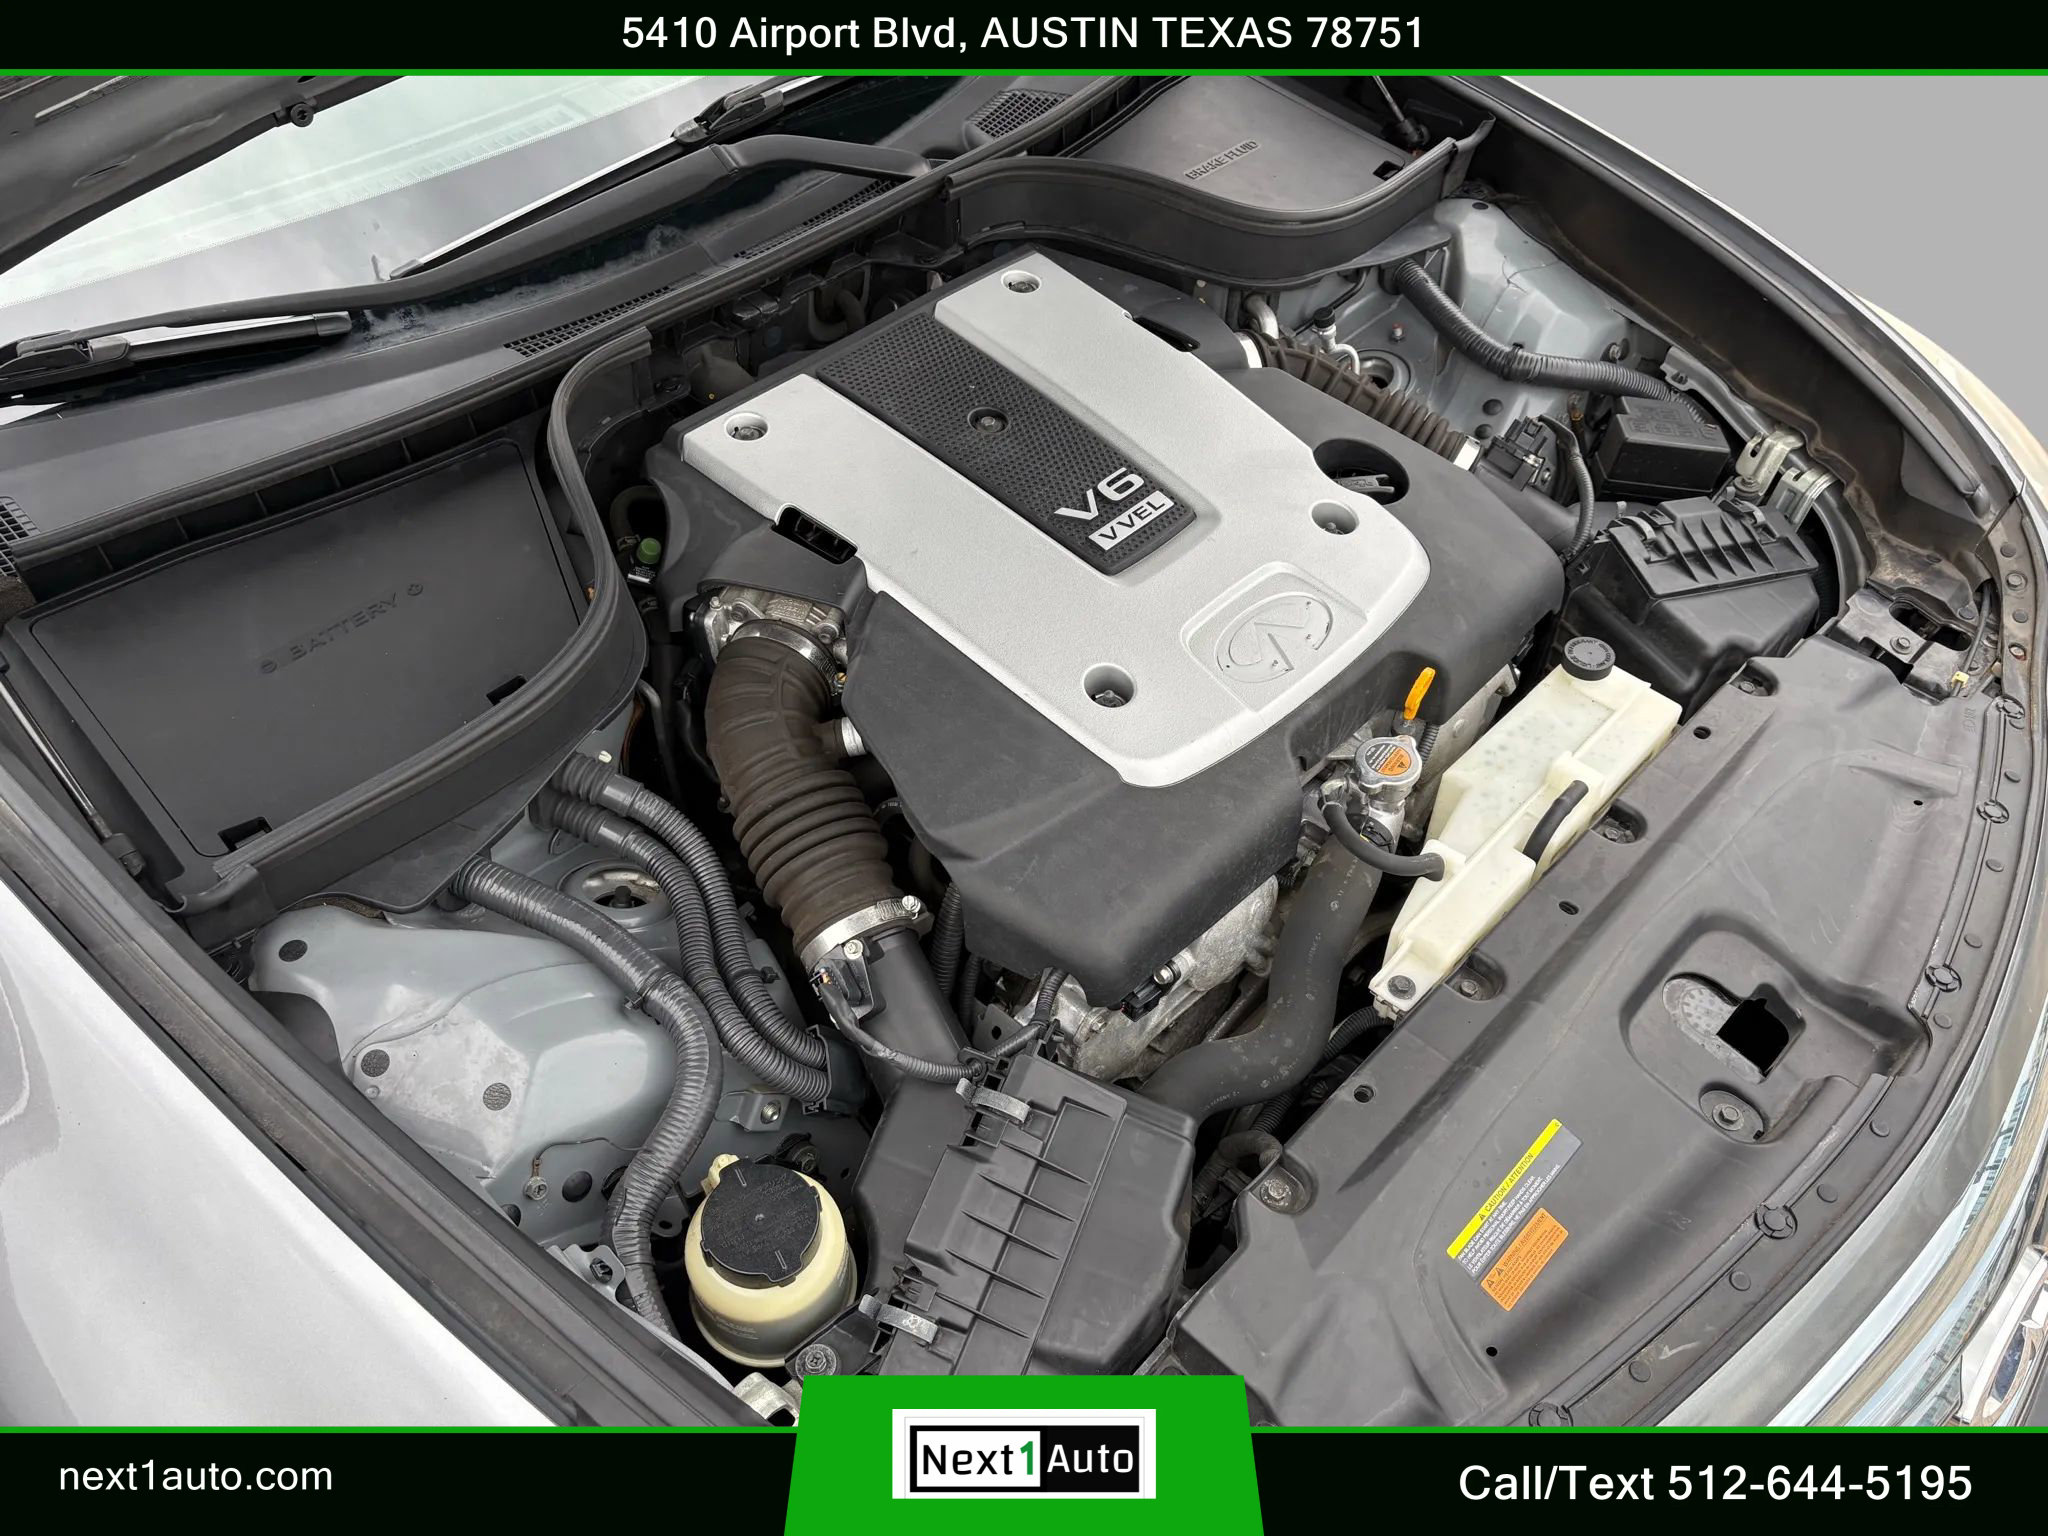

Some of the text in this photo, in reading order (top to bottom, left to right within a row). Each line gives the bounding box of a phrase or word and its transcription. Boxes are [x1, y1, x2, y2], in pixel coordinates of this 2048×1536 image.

[1184, 140, 1259, 180] BRAKE FLUID
[1054, 467, 1145, 521] V6
[1098, 499, 1166, 541] VVEL
[290, 592, 399, 662] BATTERY
[1483, 1185, 1507, 1213] CAUTION
[1506, 1151, 1534, 1184] ATTENTION
